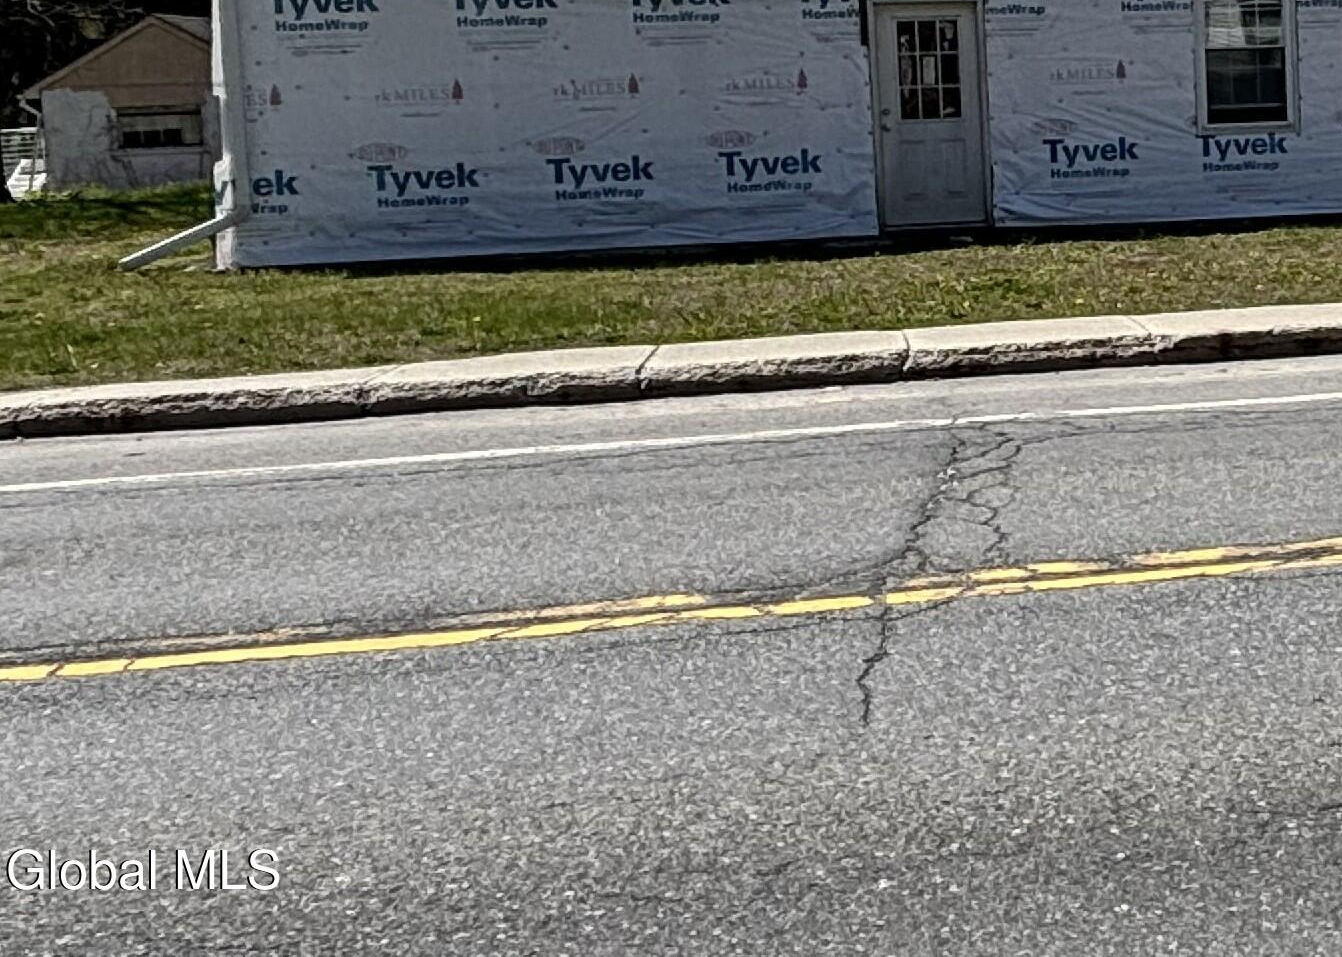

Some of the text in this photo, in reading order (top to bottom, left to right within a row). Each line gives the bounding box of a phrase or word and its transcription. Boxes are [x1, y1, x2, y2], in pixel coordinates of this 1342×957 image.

[1121, 0, 1192, 12] HomeWra
[633, 11, 720, 24] HomeWrap
[802, 8, 860, 19] HomeW
[275, 19, 369, 32] HomeWrap
[457, 15, 548, 28] HomeWrap
[1043, 137, 1139, 168] Tyvek
[1196, 132, 1288, 161] Tyvek
[546, 155, 654, 188] Tyvek
[718, 148, 822, 182] Tyvek
[1051, 166, 1130, 179] HomeWrap
[367, 163, 480, 197] Tyvek
[727, 180, 813, 193] HomeWrap
[378, 194, 470, 208] HomeWrap
